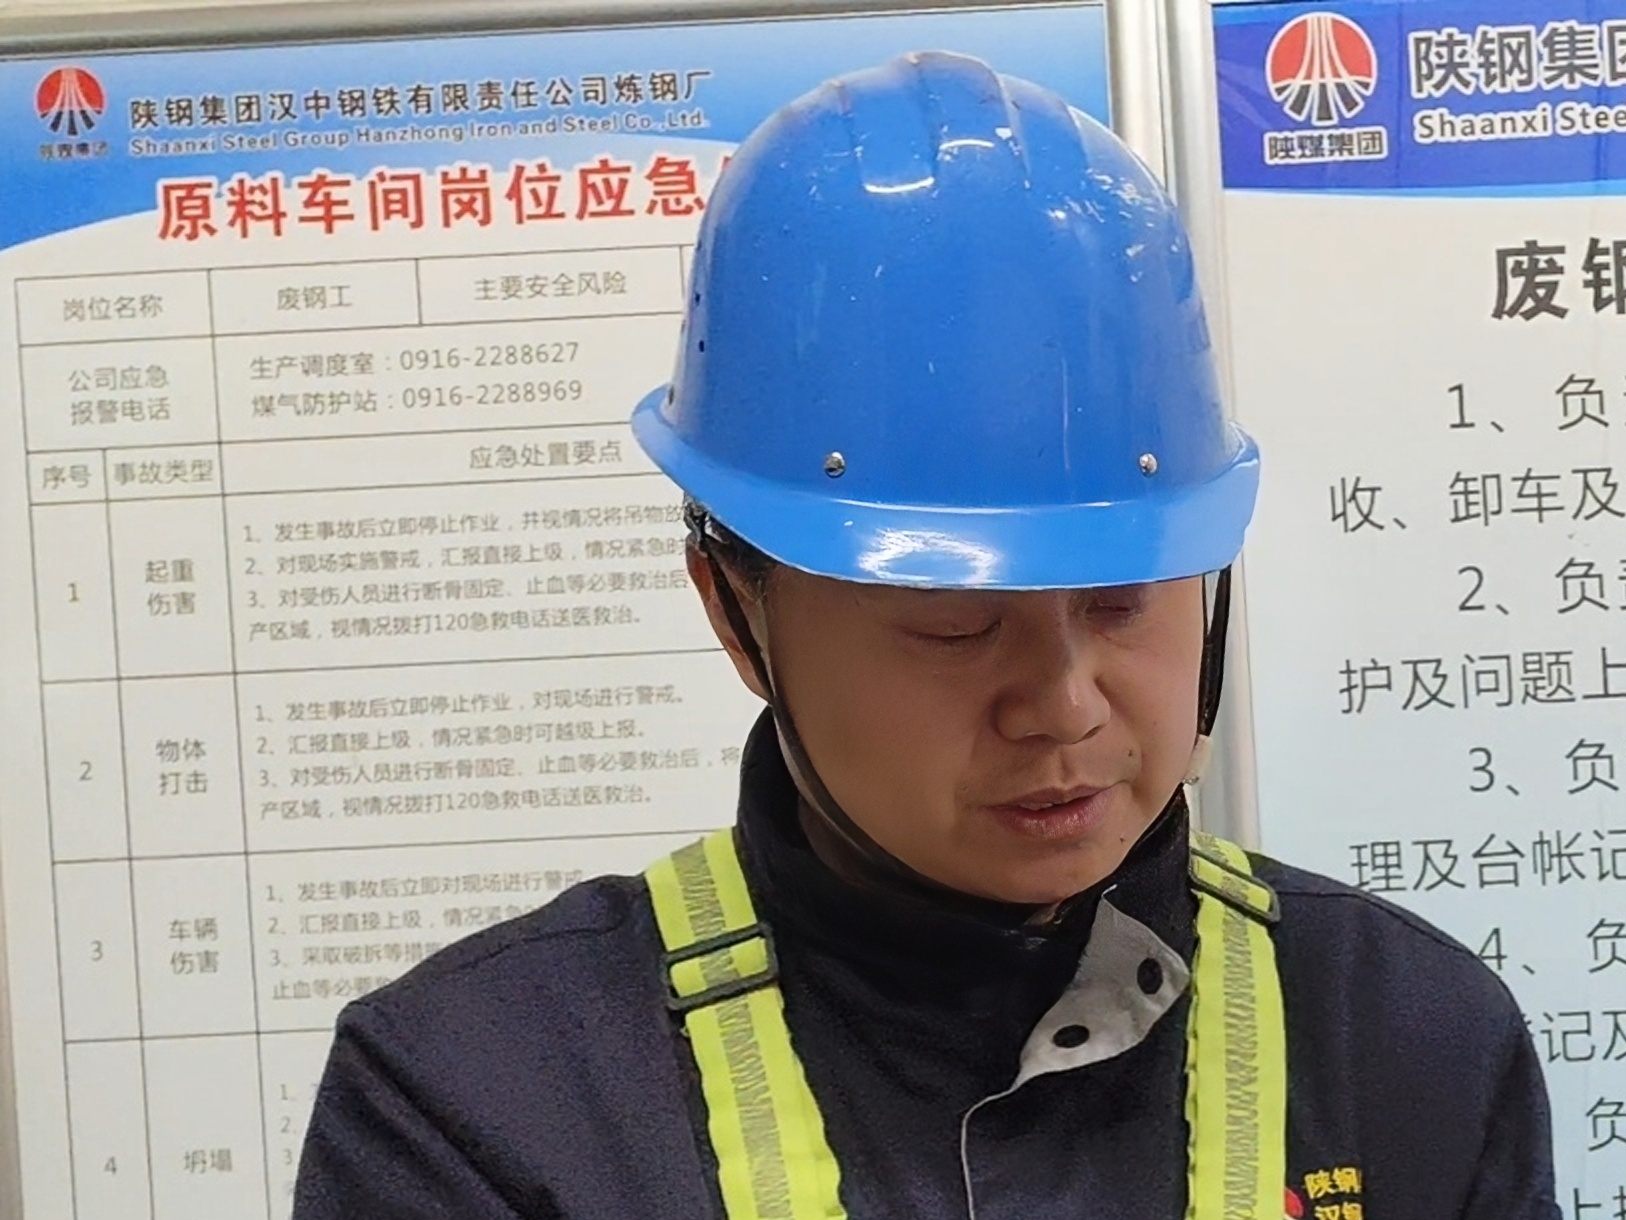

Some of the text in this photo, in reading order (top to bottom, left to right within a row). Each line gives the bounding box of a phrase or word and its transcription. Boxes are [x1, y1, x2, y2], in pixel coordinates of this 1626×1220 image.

[131, 71, 711, 128] 陕钢集团汉中钢铁有限责任公司炼钢厂
[131, 137, 215, 154] Shaanxi
[223, 134, 277, 149] Steel
[284, 130, 349, 147] Group
[356, 124, 463, 142] Hanzhong
[470, 123, 512, 137] Iron
[519, 119, 556, 134] and
[563, 116, 618, 133] Steel
[1418, 106, 1550, 140] Shaanxi
[1267, 131, 1386, 160] 陕煤集团
[159, 156, 732, 241] 原料车间岗位应急
[277, 285, 352, 311] 废钢工
[475, 271, 627, 301] 主要安全风险
[63, 294, 163, 321] 岗位名称
[68, 364, 169, 392] 公司应急
[71, 397, 171, 425] 报警电话
[469, 441, 622, 469] 应急处置要点
[42, 465, 92, 490] 序号
[114, 459, 213, 485] 事故类型
[144, 560, 195, 585] 起重
[67, 582, 80, 602] 1
[146, 591, 196, 616] 伤害
[155, 739, 207, 762] 物体
[80, 761, 92, 781] 2
[158, 771, 208, 796] 打击
[168, 917, 219, 943] 车辆
[91, 941, 103, 961] 3
[170, 949, 219, 975] 伤害
[105, 1155, 117, 1177] 4
[184, 1149, 232, 1174] 坍塌
[1304, 1167, 1362, 1199] 陕钢
